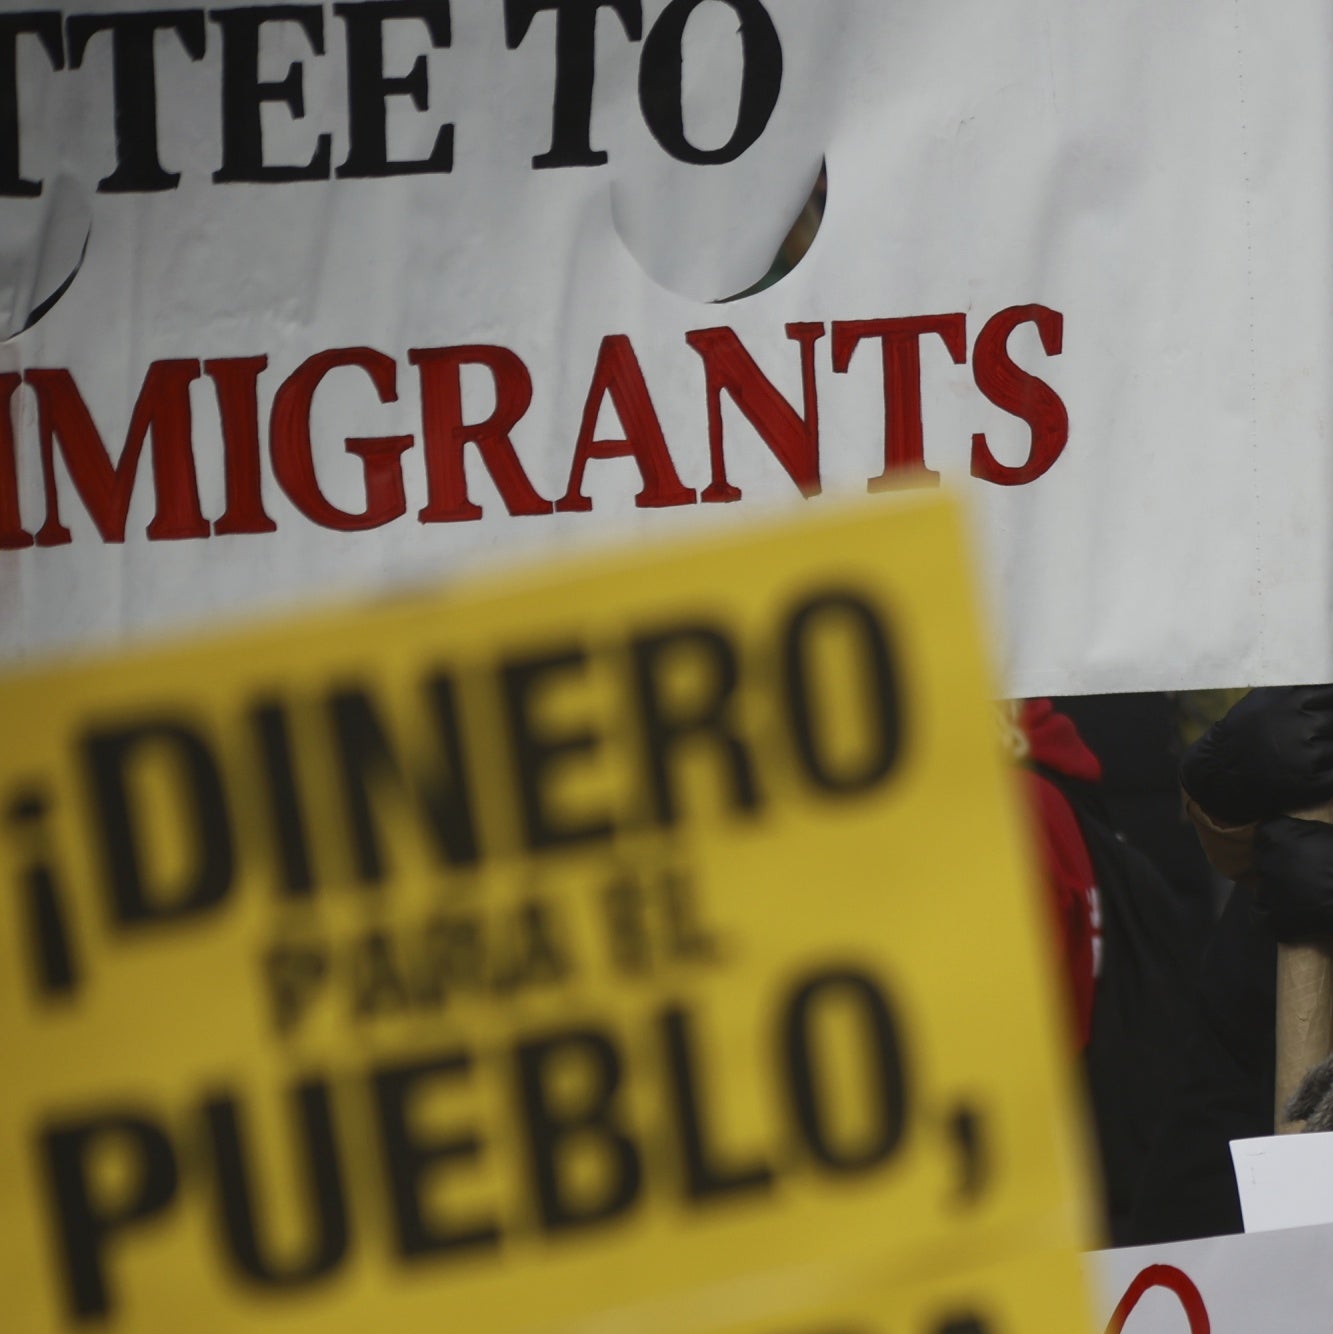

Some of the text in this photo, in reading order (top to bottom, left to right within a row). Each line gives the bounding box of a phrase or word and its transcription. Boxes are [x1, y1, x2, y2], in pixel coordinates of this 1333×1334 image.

[506, 0, 784, 170] TO
[0, 303, 1068, 550] MIGRANTS
[12, 580, 915, 1005] ¡DINERO
[36, 960, 992, 1334] PUEBLO,
